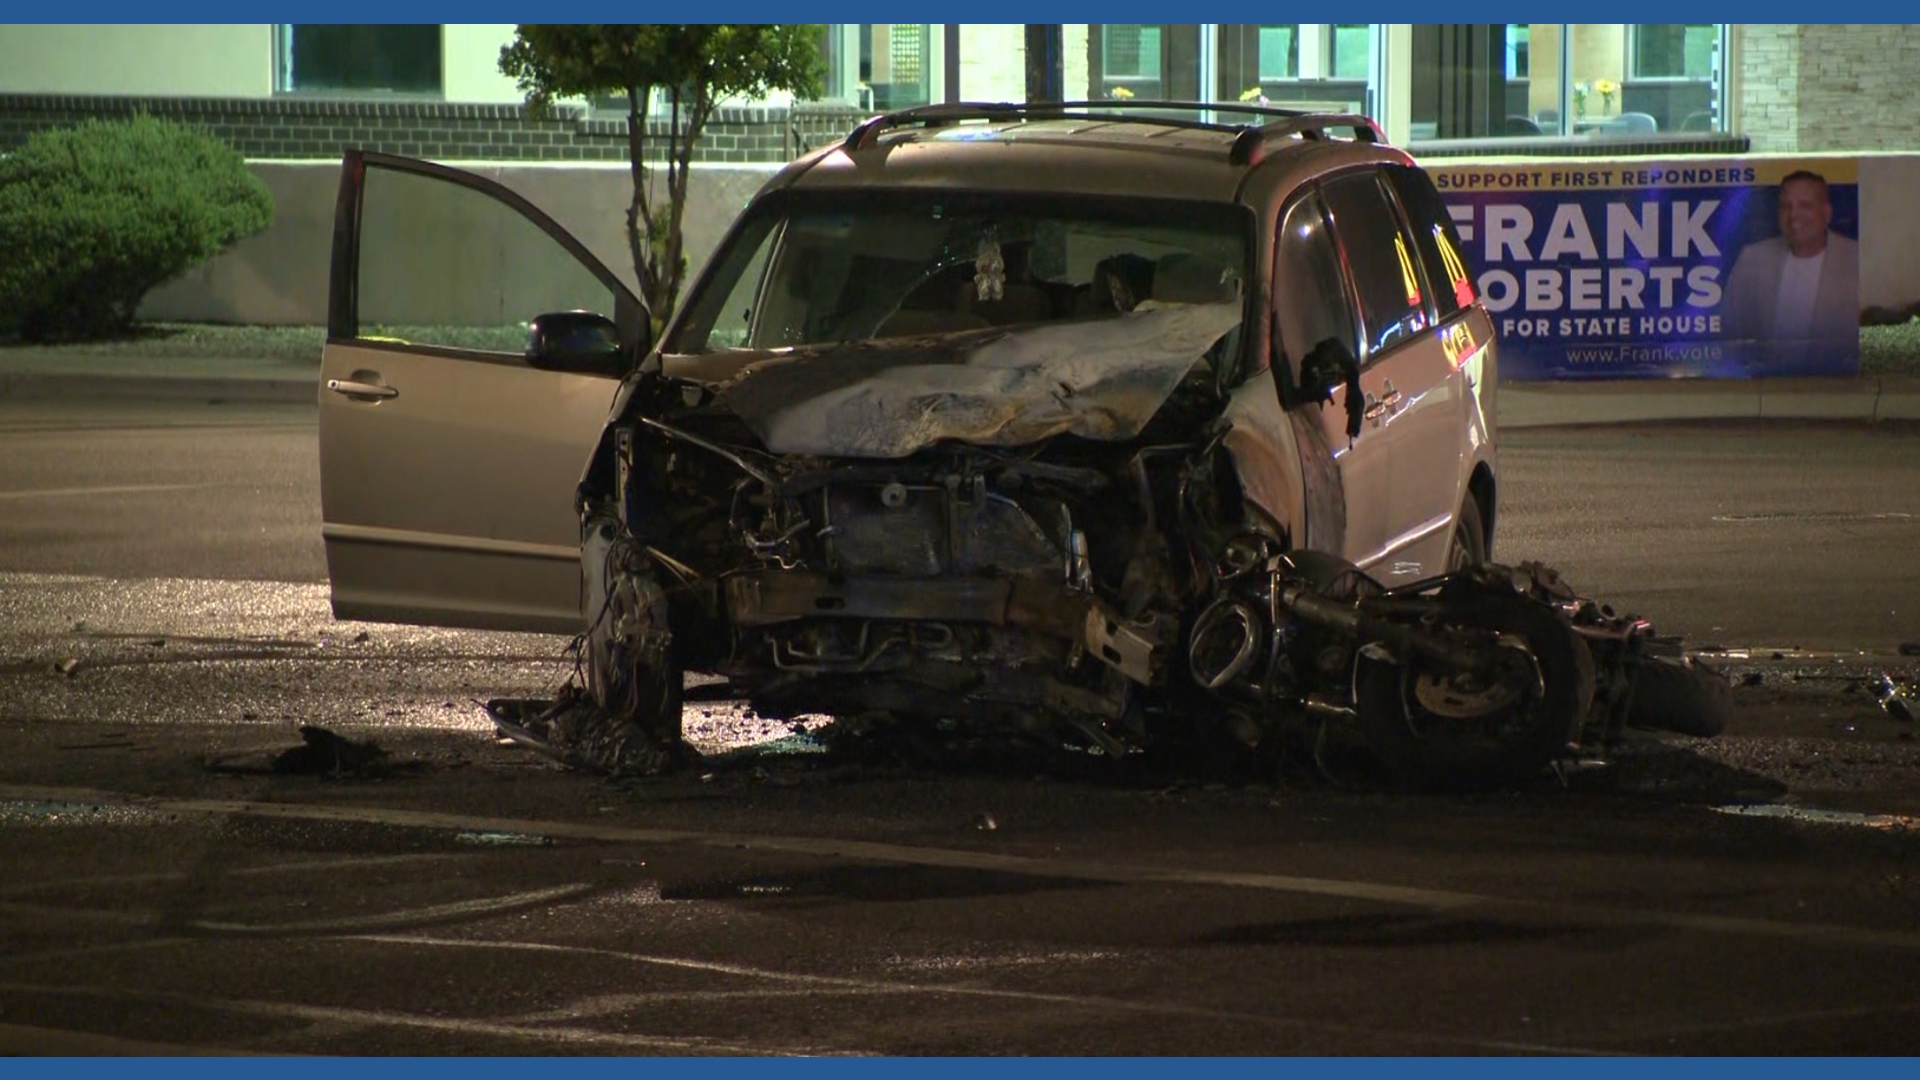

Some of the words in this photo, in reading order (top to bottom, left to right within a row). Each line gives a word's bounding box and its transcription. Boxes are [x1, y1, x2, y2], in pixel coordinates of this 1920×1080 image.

[1437, 172, 1543, 189] SUPPORT
[1551, 171, 1613, 187] FIRST
[1621, 168, 1756, 186] REPONDERS
[1477, 265, 1723, 312] OBERTS
[1503, 319, 1549, 338] FOR
[1559, 317, 1630, 336] STATE
[1640, 315, 1722, 334] HOUSE
[1566, 345, 1723, 364] www.Frank.vote
